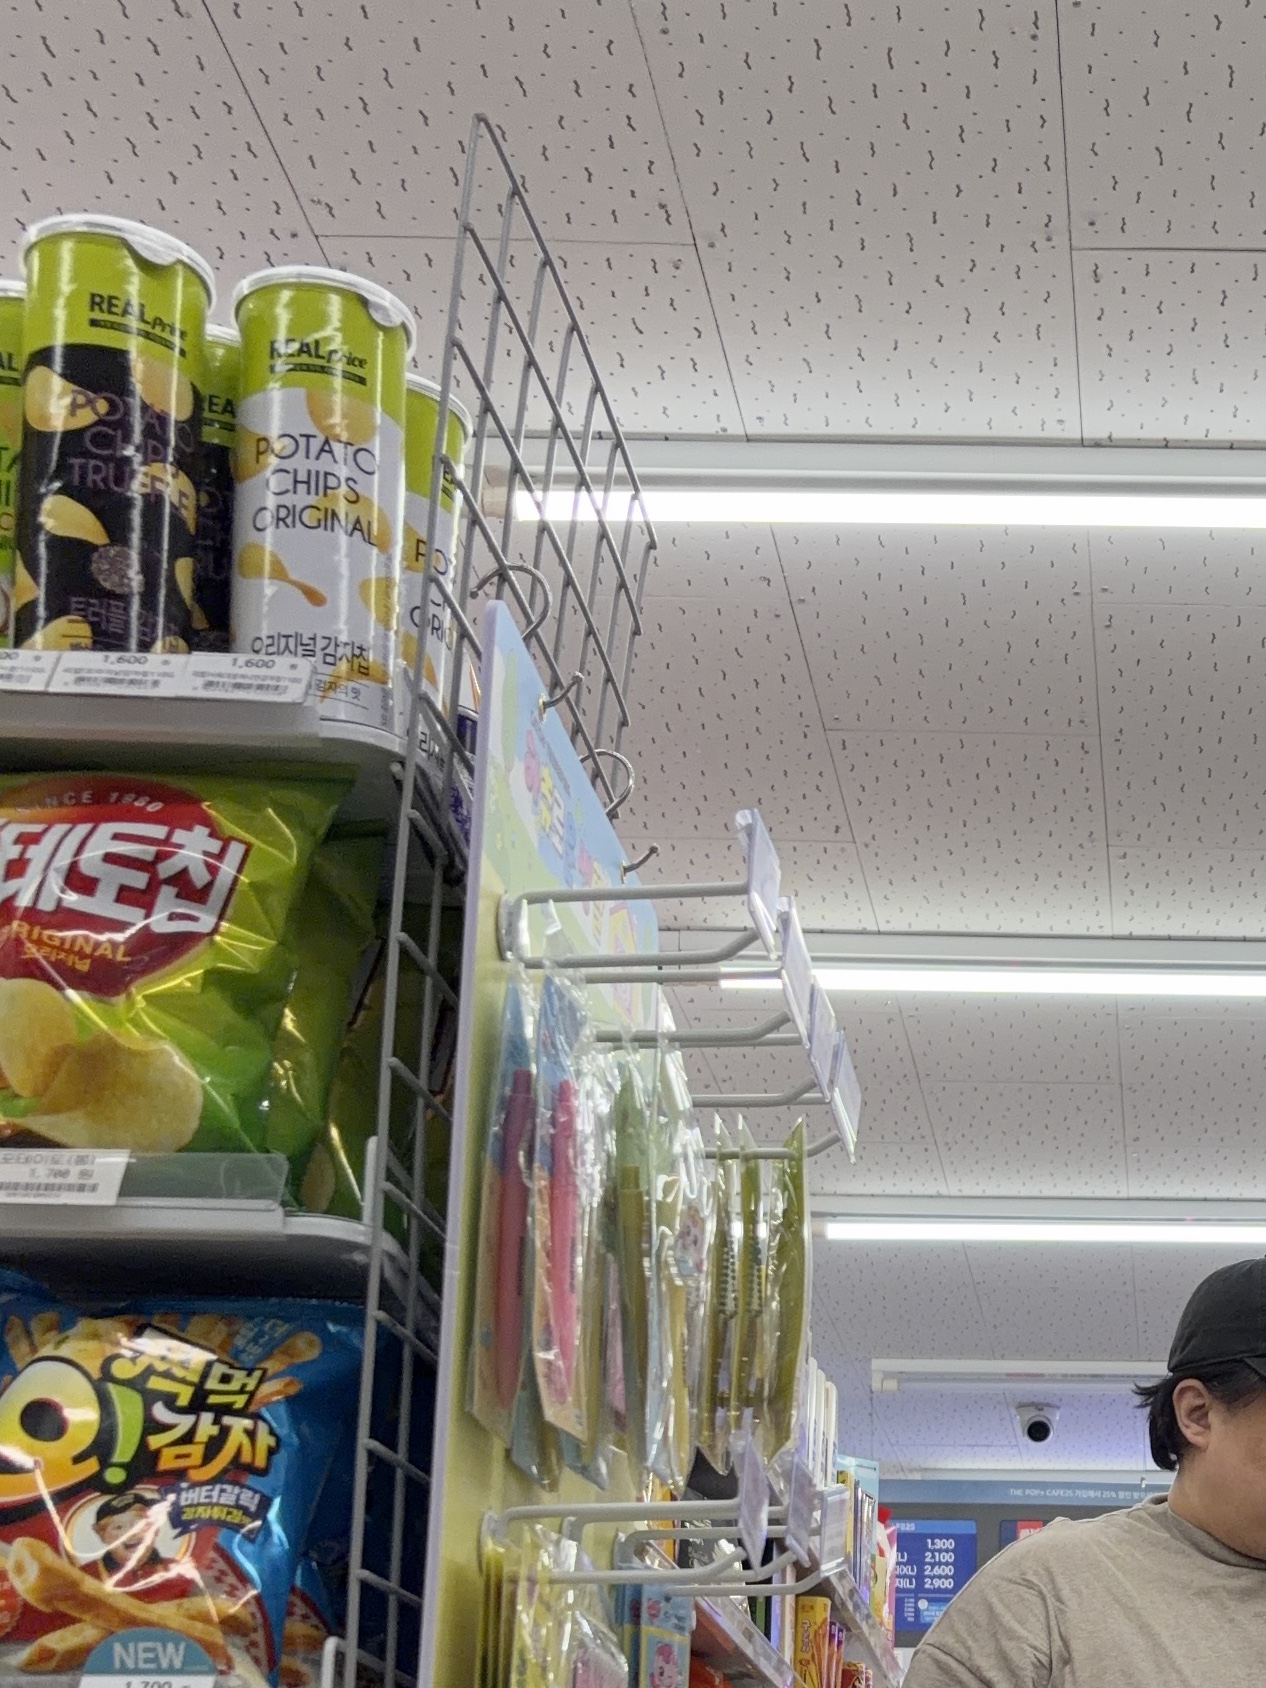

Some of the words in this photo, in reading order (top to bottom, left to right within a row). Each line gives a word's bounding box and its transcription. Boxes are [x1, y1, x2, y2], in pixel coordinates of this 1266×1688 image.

[255, 433, 378, 476] POTATO
[266, 467, 361, 505] CHIPS
[251, 503, 378, 547] ORIGINAL
[251, 631, 317, 659] 오리지널
[924, 1552, 955, 1564] 2,100
[926, 1539, 955, 1550] 1,300
[924, 1565, 955, 1576] 2,600
[924, 1578, 955, 1590] 2,900
[112, 1641, 187, 1670] NEW
